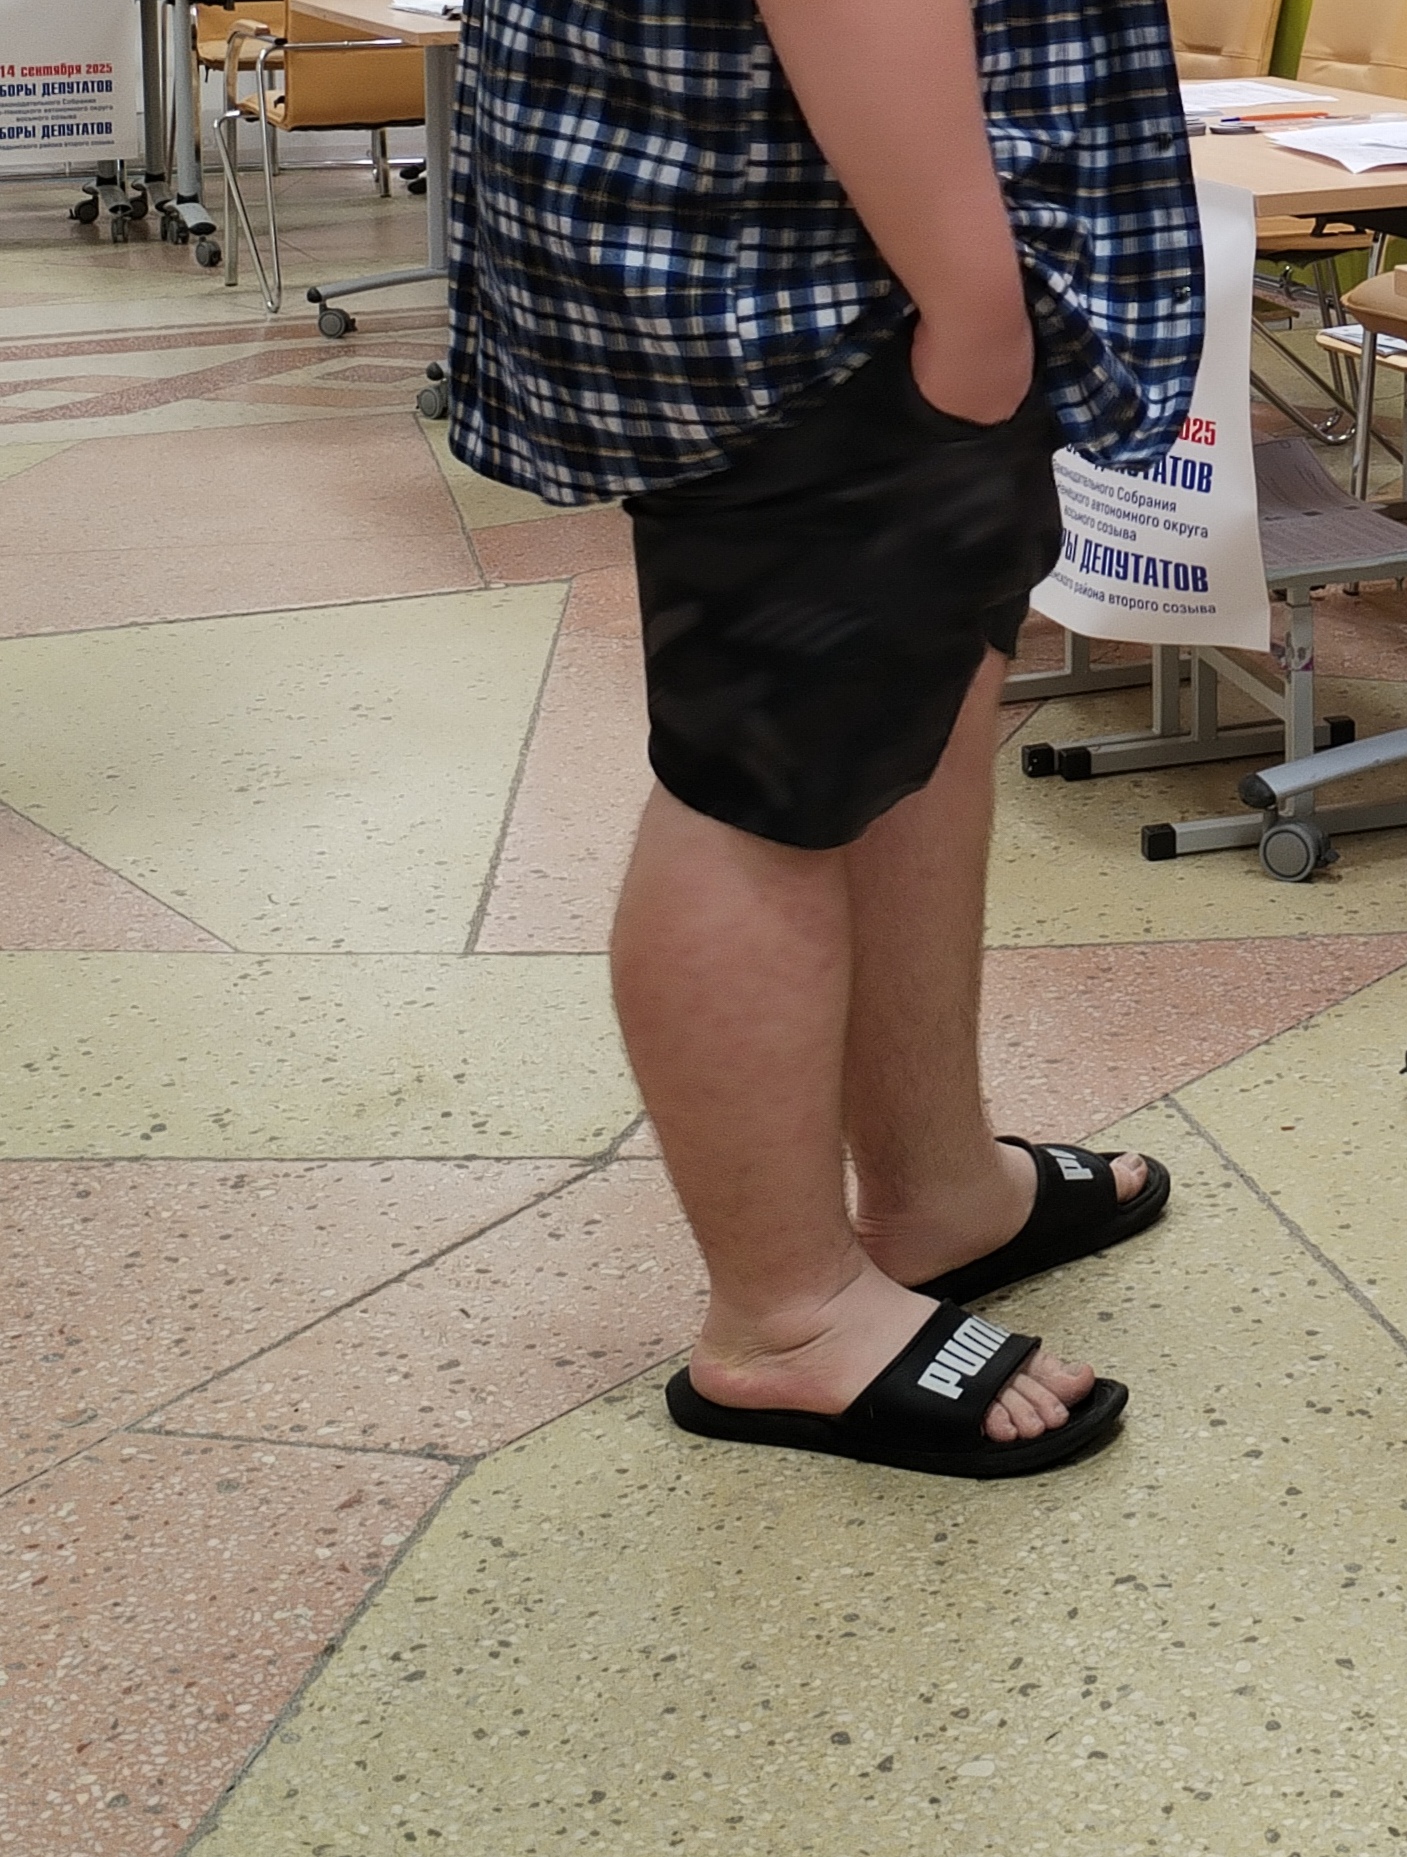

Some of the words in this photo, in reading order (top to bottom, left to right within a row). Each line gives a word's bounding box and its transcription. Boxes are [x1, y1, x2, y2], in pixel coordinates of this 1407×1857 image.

[21, 63, 82, 78] сентября
[86, 63, 113, 75] 2025
[0, 83, 36, 98] БОРЫ
[42, 80, 113, 97] ДЕПУТАТОВ
[0, 125, 36, 140] БОРЫ
[41, 122, 113, 140] ДЕПУТАТОВ
[1179, 416, 1216, 446] 025
[1117, 486, 1177, 514] Собрания
[1091, 499, 1160, 529] автономного
[1163, 518, 1209, 539] округа
[1097, 519, 1137, 542] созыва
[1079, 538, 1209, 593] ДЕПУТАТОВ
[1108, 592, 1159, 612] второго
[1163, 601, 1217, 615] созыва
